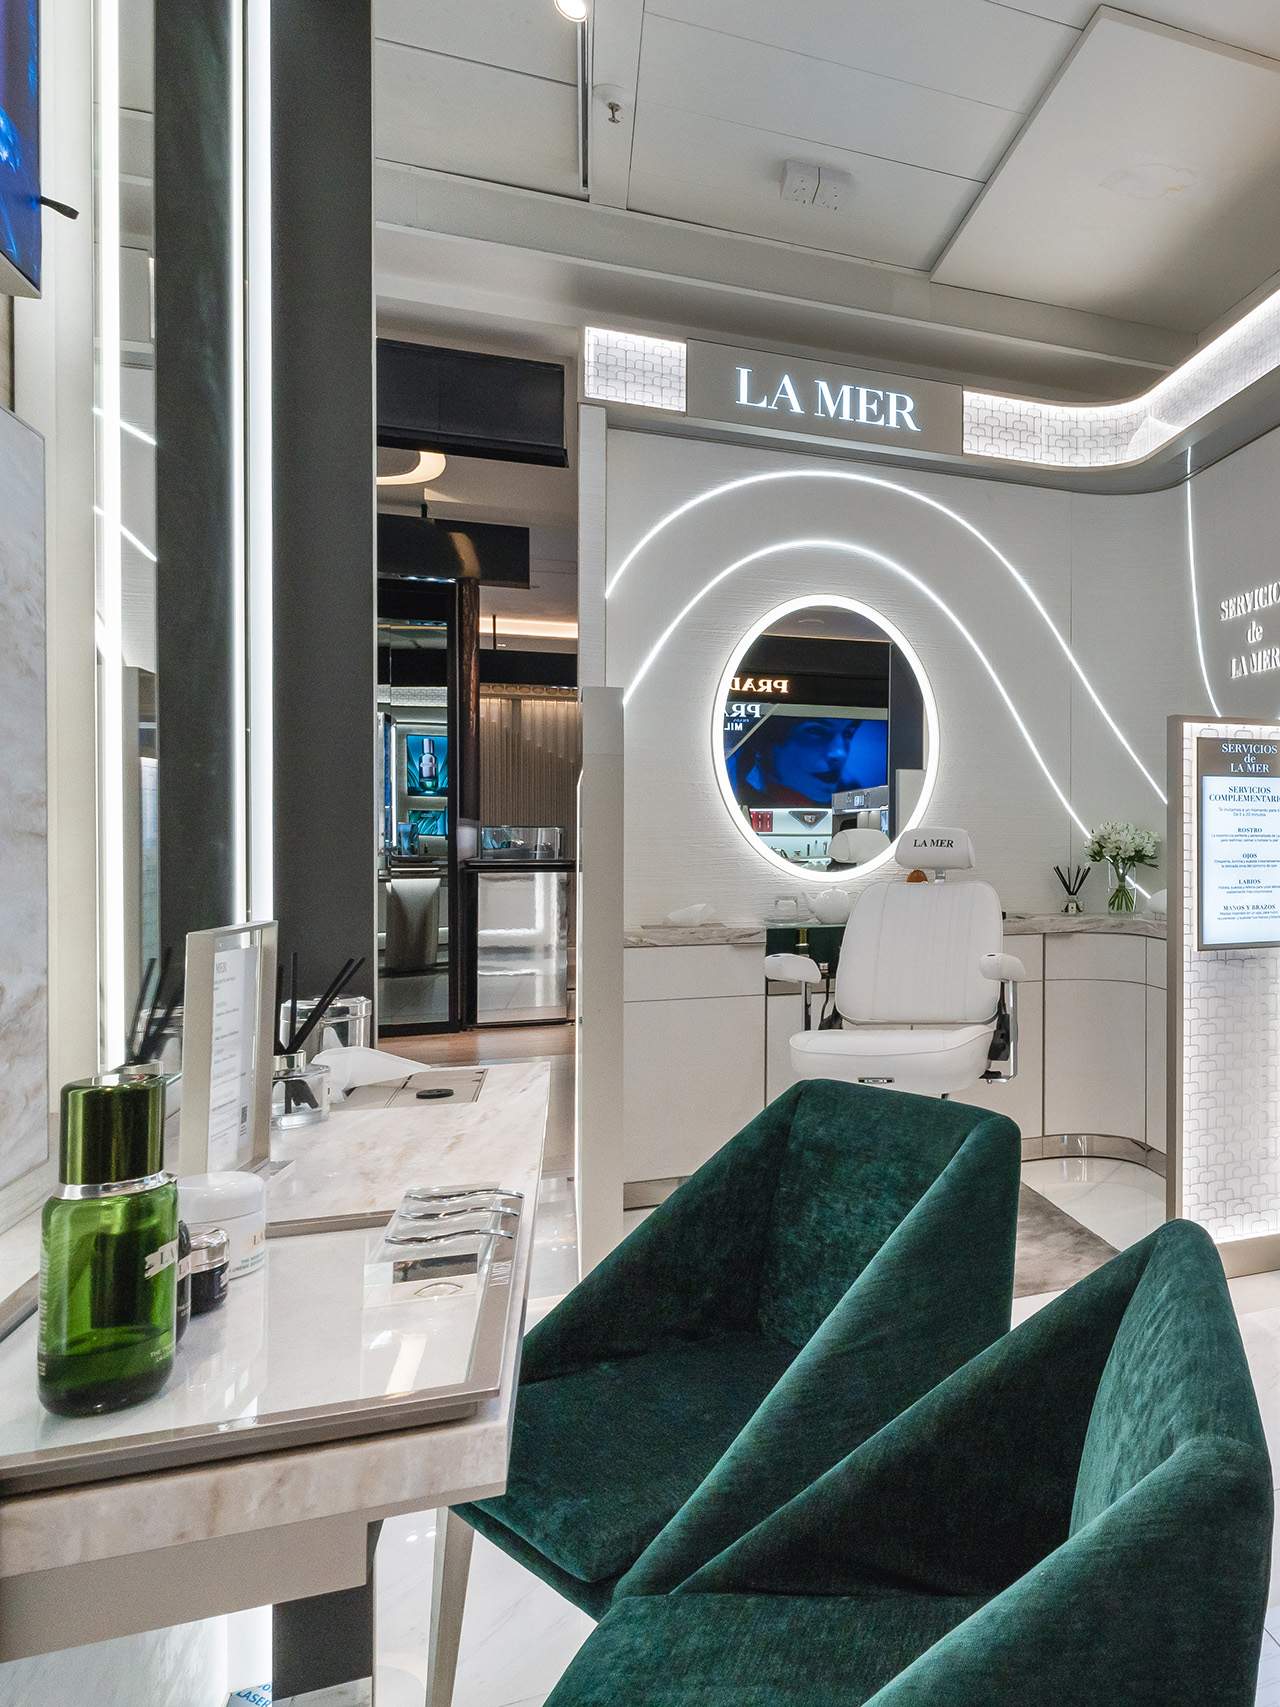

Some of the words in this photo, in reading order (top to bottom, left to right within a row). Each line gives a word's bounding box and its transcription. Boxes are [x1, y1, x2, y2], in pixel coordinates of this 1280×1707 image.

[735, 366, 805, 414] LA
[814, 379, 922, 432] MER
[1247, 621, 1263, 643] de
[1231, 655, 1249, 679] LA
[1221, 743, 1278, 754] SERVICIOS
[1243, 753, 1256, 763] de
[1230, 763, 1244, 773] LA
[1246, 763, 1270, 773] MER
[1228, 785, 1272, 794] SERVICIOS
[913, 838, 928, 848] LA
[930, 838, 954, 848] MER
